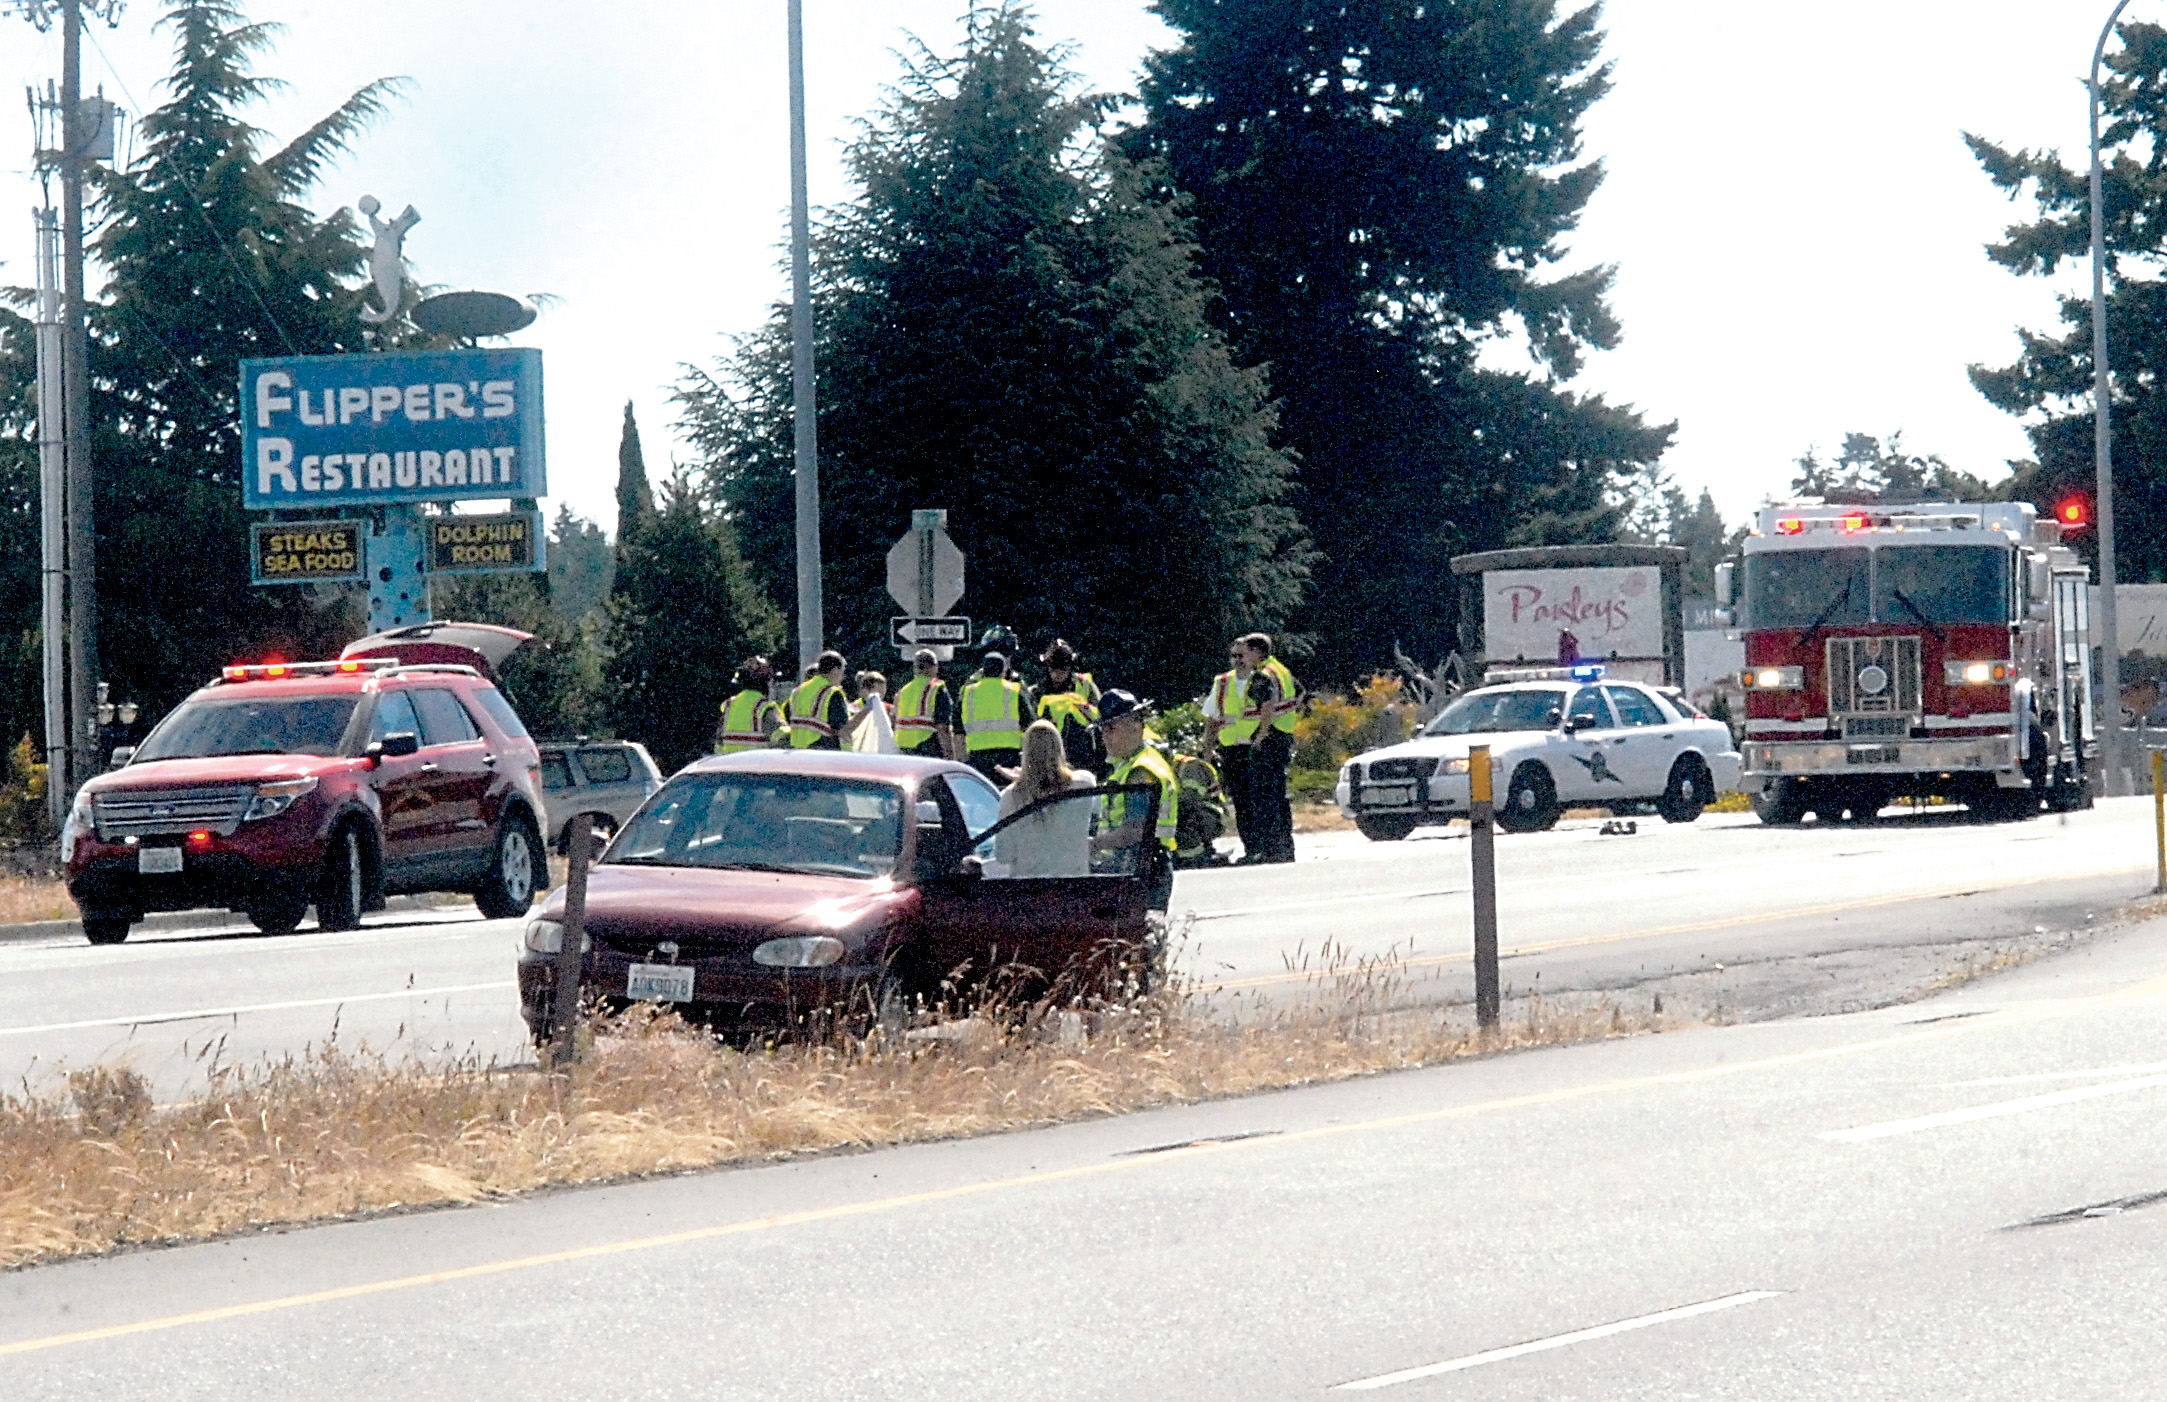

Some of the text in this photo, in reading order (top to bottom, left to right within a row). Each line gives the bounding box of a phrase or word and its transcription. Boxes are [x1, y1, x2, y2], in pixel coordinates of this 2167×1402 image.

[255, 371, 515, 429] FLIPPER'S
[256, 436, 515, 494] RESTAURANT
[269, 532, 347, 552] STEAKS
[438, 523, 523, 544] DOLPHIN
[264, 551, 355, 572] SEA FOOD
[453, 543, 511, 562] ROOM
[1497, 584, 1629, 640] Paisleys
[938, 624, 961, 638] WAY
